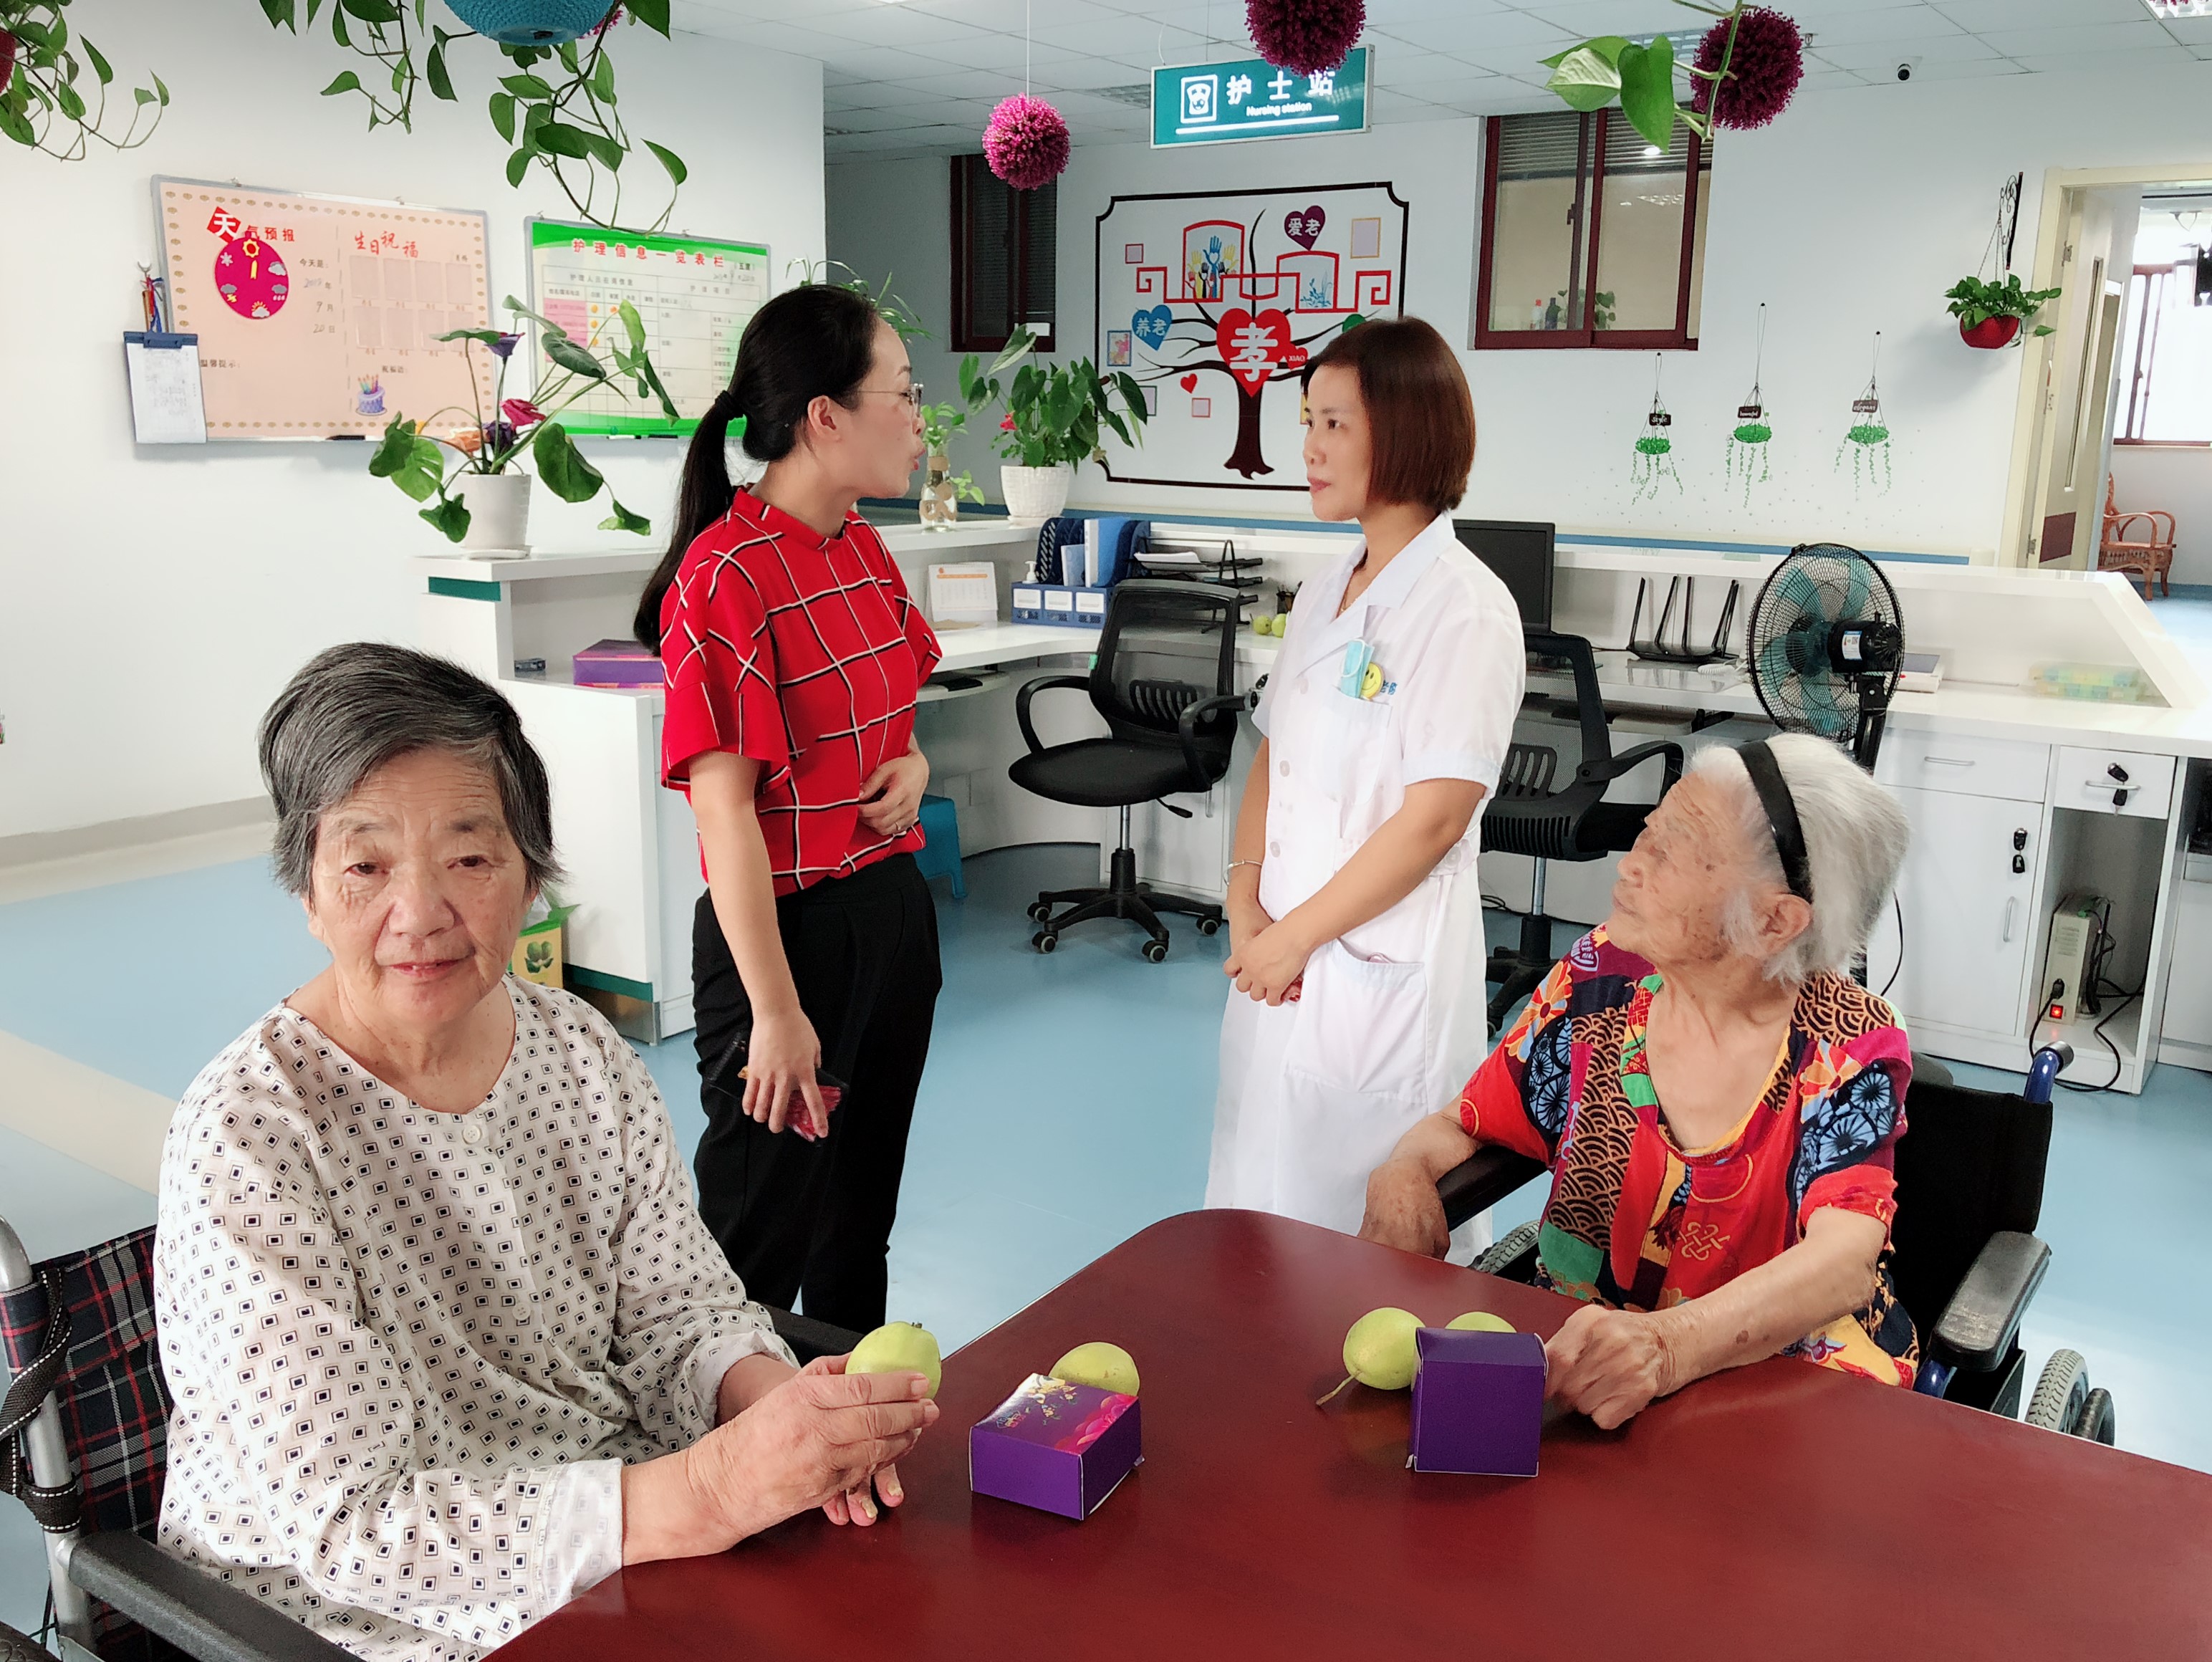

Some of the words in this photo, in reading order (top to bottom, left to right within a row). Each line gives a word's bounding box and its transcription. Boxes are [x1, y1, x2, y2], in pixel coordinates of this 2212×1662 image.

[1226, 66, 1335, 105] 护士站
[1246, 105, 1281, 116] Nursing
[1281, 101, 1312, 113] station
[213, 213, 295, 242] 天气预报
[1288, 218, 1320, 236] 爱老
[355, 231, 418, 258] 生日祝福
[573, 240, 723, 268] 护理信息一览表栏
[1136, 317, 1167, 337] 养老
[1229, 322, 1279, 383] 孝
